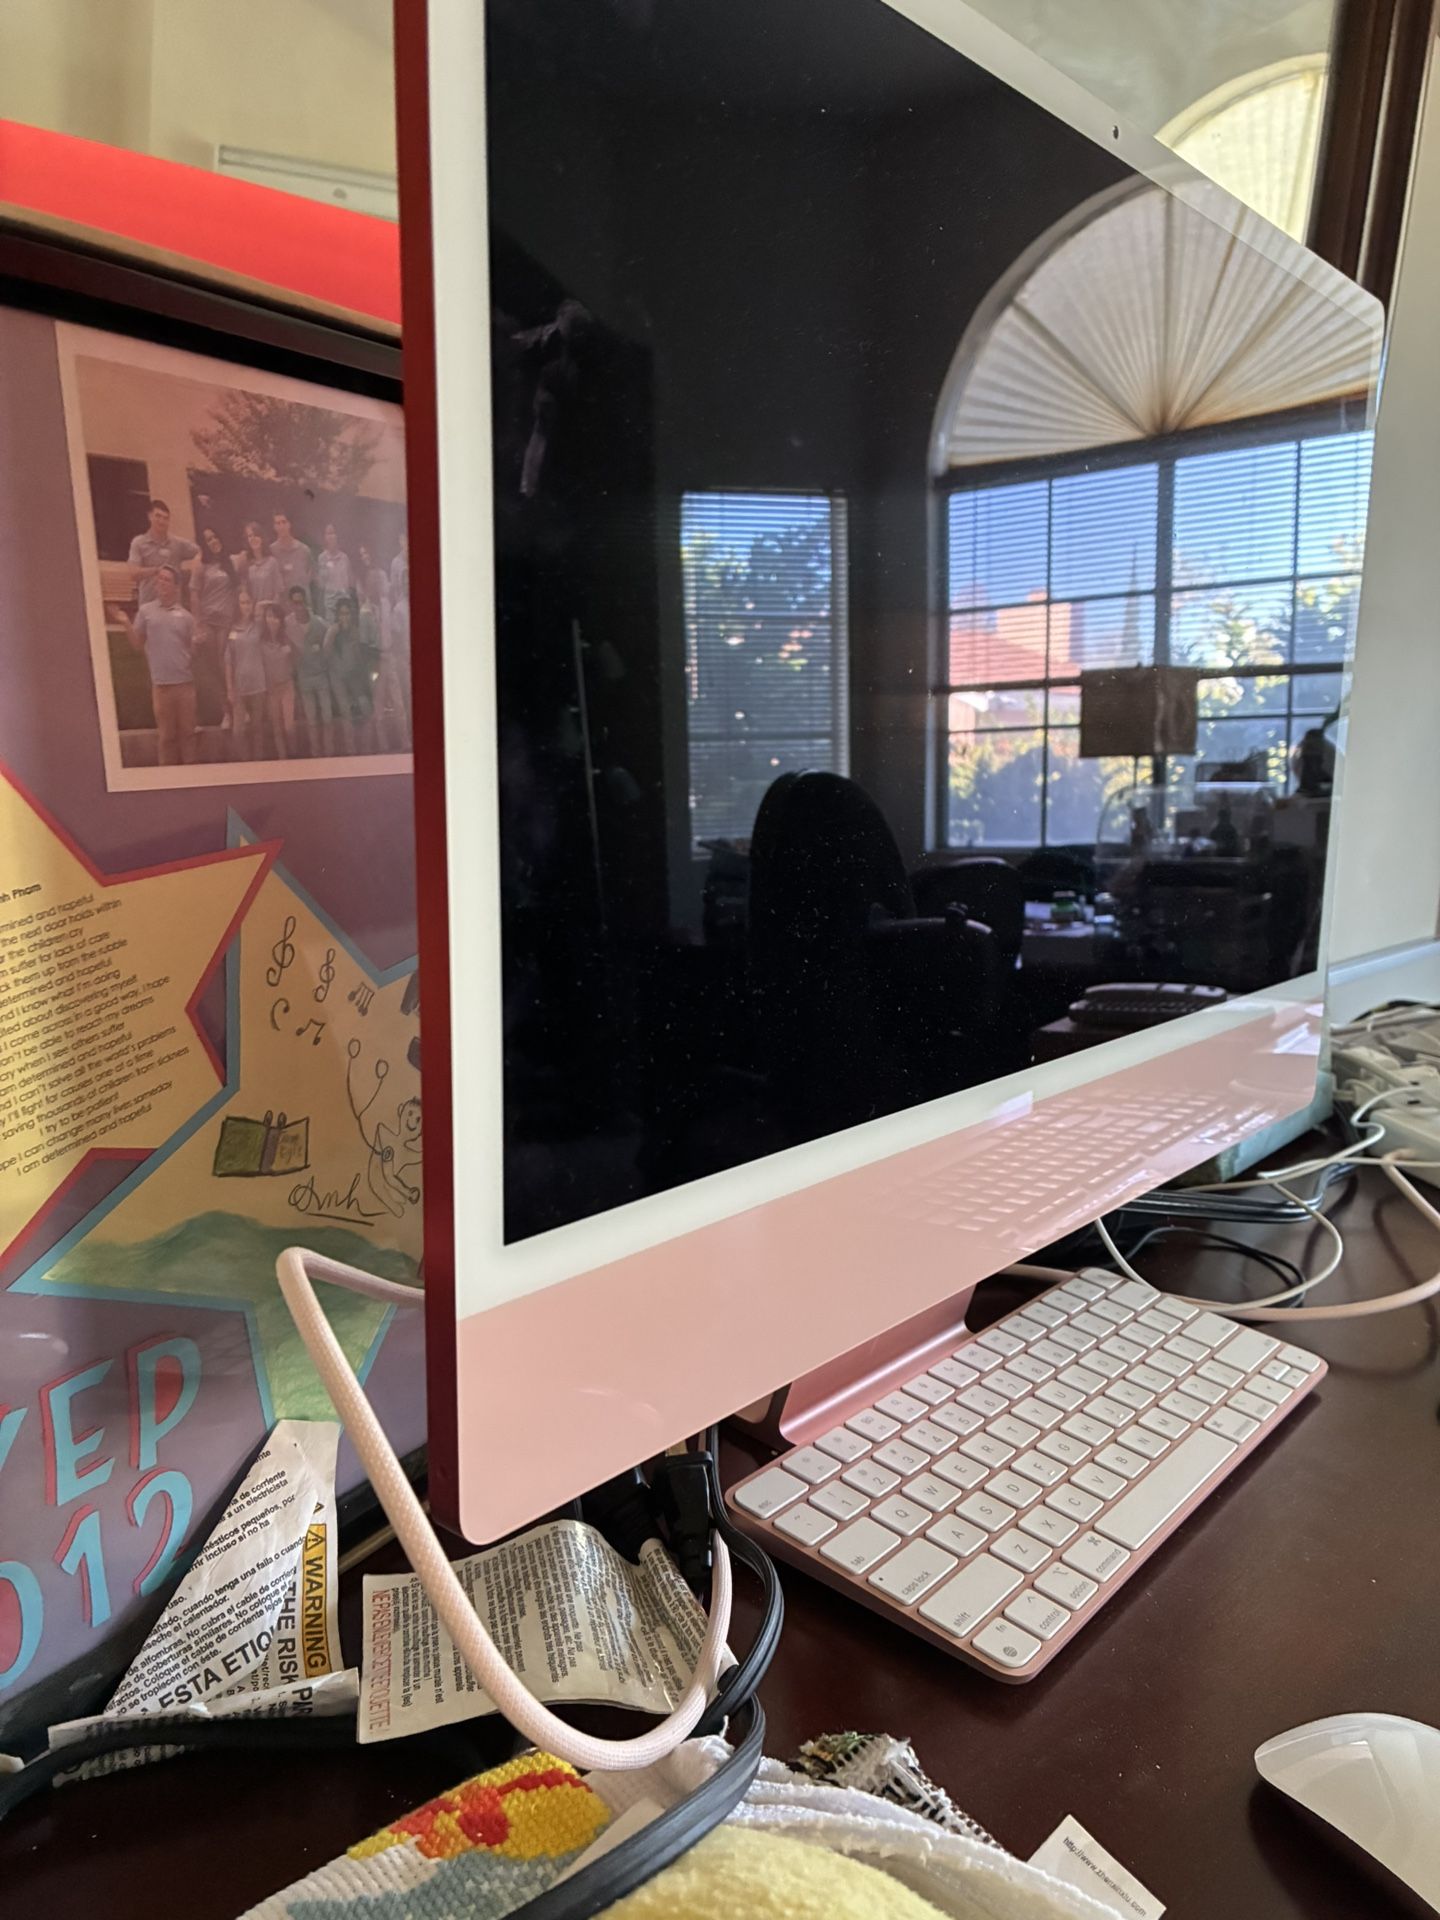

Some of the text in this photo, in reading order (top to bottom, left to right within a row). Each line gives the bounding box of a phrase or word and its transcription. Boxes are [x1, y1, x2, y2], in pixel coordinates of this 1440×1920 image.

[902, 1456, 914, 1464] 3
[1115, 1456, 1128, 1465] B
[953, 1464, 967, 1474] E
[238, 1468, 287, 1500] de corriente
[873, 1477, 885, 1486] 2
[1006, 1483, 1020, 1493] D
[1091, 1475, 1104, 1484] V
[232, 1502, 246, 1513] un
[244, 1477, 289, 1506] electricista
[924, 1485, 938, 1496] W
[979, 1505, 993, 1515] S
[1068, 1497, 1081, 1506] C
[895, 1509, 909, 1519] Q
[1042, 1519, 1056, 1530] X
[951, 1529, 965, 1540] A
[203, 1537, 238, 1562] incluso
[245, 1525, 259, 1537] no
[1014, 1543, 1029, 1554] Z
[850, 1555, 865, 1567] tab
[1095, 1548, 1122, 1573] command
[180, 1592, 215, 1616] cuando
[213, 1576, 240, 1596] tenga
[238, 1566, 257, 1581] una
[901, 1570, 932, 1596] caps lock
[1069, 1580, 1090, 1600] option
[171, 1592, 231, 1633] el calentador.
[276, 1581, 297, 1631] THE
[304, 1555, 328, 1669] WARNING
[953, 1611, 970, 1628] shift
[1039, 1609, 1062, 1631] control
[138, 1635, 187, 1669] alfombras.
[185, 1626, 201, 1640] No
[199, 1610, 227, 1631] cubra
[224, 1604, 235, 1615] el
[233, 1589, 259, 1609] cable
[131, 1670, 146, 1684] de
[144, 1641, 193, 1675] coberturas
[233, 1606, 248, 1620] No
[142, 1660, 182, 1689] Coloque
[179, 1654, 191, 1665] el
[188, 1638, 215, 1659] cable
[213, 1630, 227, 1643] de
[225, 1607, 265, 1635] corriente
[218, 1626, 282, 1674] ETIQ
[181, 1660, 200, 1675] con
